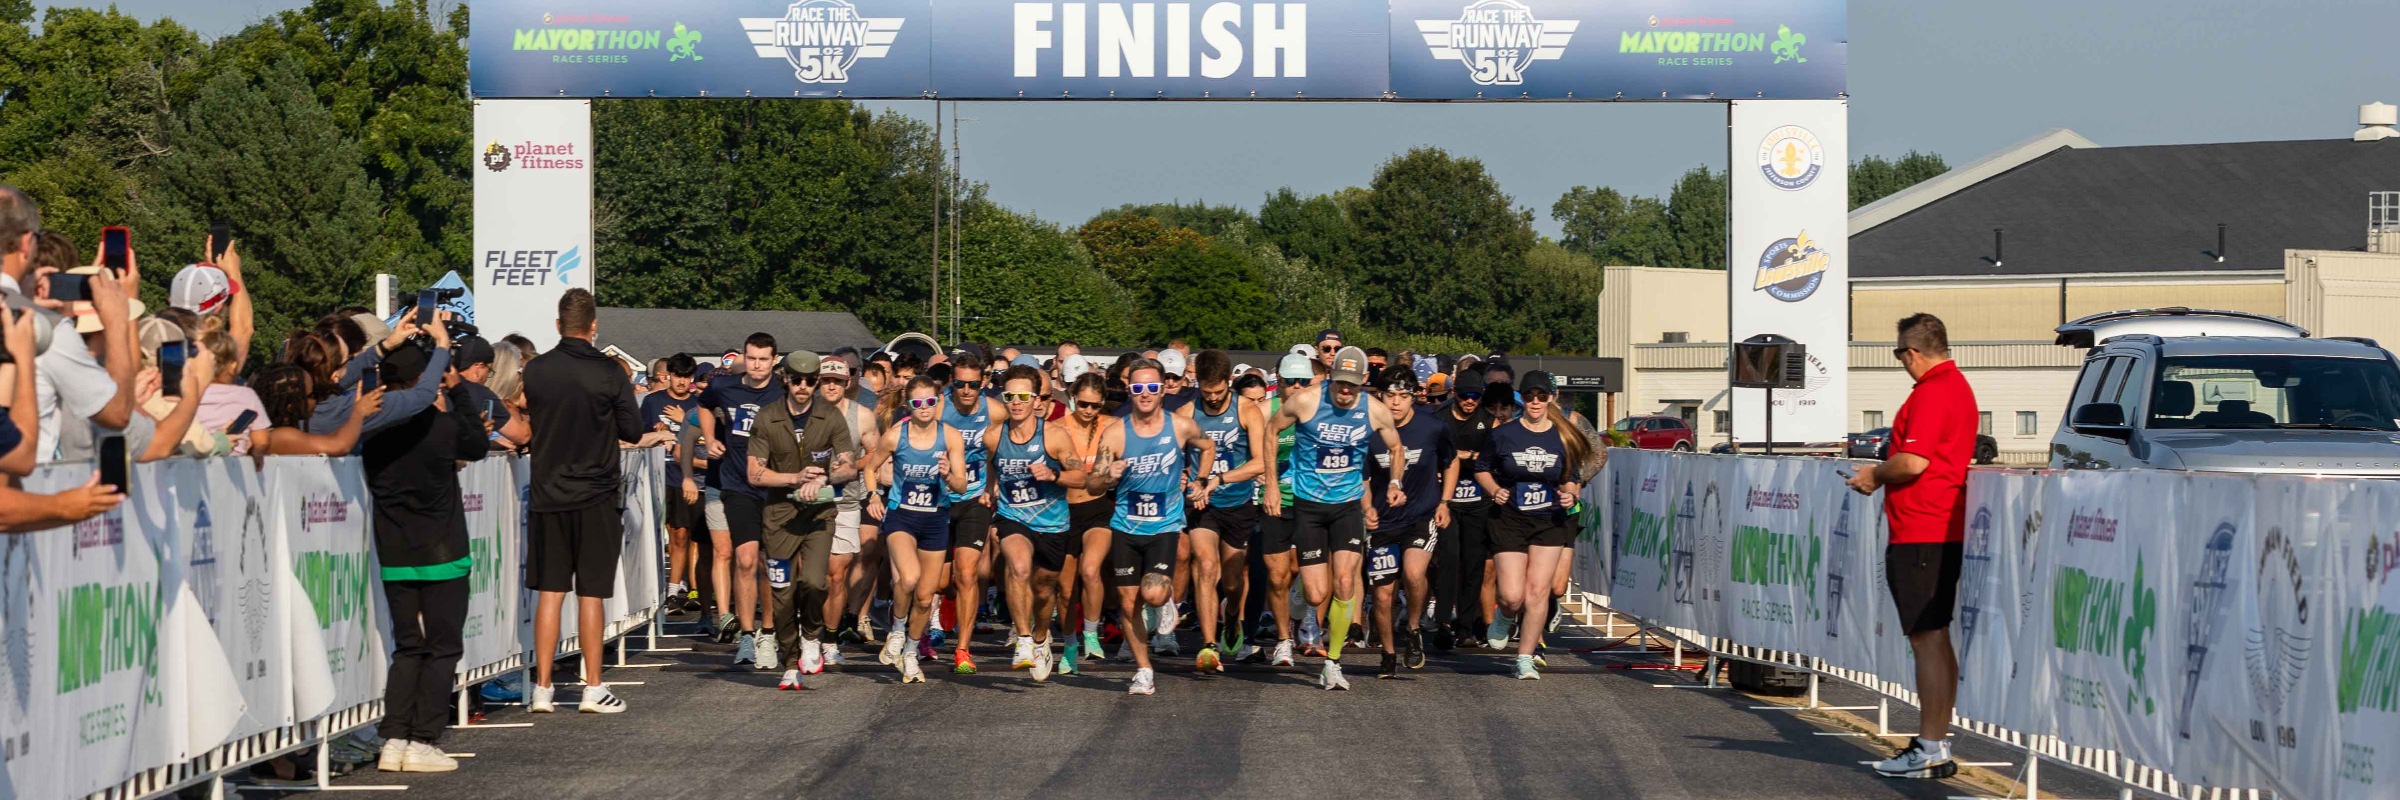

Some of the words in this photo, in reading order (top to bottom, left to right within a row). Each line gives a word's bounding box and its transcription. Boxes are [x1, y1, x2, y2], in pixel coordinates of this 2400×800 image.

[792, 7, 824, 22] RACE
[827, 7, 851, 22] THE
[1467, 9, 1499, 24] RACE
[1502, 9, 1526, 23] THE
[513, 28, 661, 51] MAYORTHON
[776, 22, 868, 47] RUNWAY
[1014, 2, 1306, 78] FINISH
[1451, 24, 1543, 48] RUNWAY
[1619, 31, 1765, 53] MAYORTHON
[552, 55, 583, 63] RACE
[587, 55, 628, 63] SERIES
[1658, 57, 1688, 66] RACE
[1692, 57, 1733, 66] SERIES
[514, 141, 574, 159] planet
[521, 156, 584, 169] fitness
[485, 250, 558, 268] FLEET
[1763, 241, 1788, 264] SPORTS
[1756, 249, 1829, 288] Louisville
[492, 268, 551, 286] FEET
[1771, 276, 1820, 299] COMMISSION
[454, 300, 474, 319] CLU
[741, 418, 754, 431] 17
[1317, 423, 1353, 434] FLEET
[1320, 432, 1349, 442] FEET
[998, 458, 1031, 468] FLEET
[1127, 453, 1163, 466] FLEET
[1212, 460, 1229, 474] 48
[1322, 455, 1349, 468] 439
[902, 464, 931, 472] FLEET
[1131, 462, 1160, 474] FEET
[907, 491, 932, 506] 342
[1011, 487, 1038, 503] 343
[1455, 486, 1475, 498] 372
[1524, 490, 1547, 505] 297
[1136, 502, 1158, 516] 113
[1372, 554, 1396, 570] 370
[769, 567, 785, 583] 65
